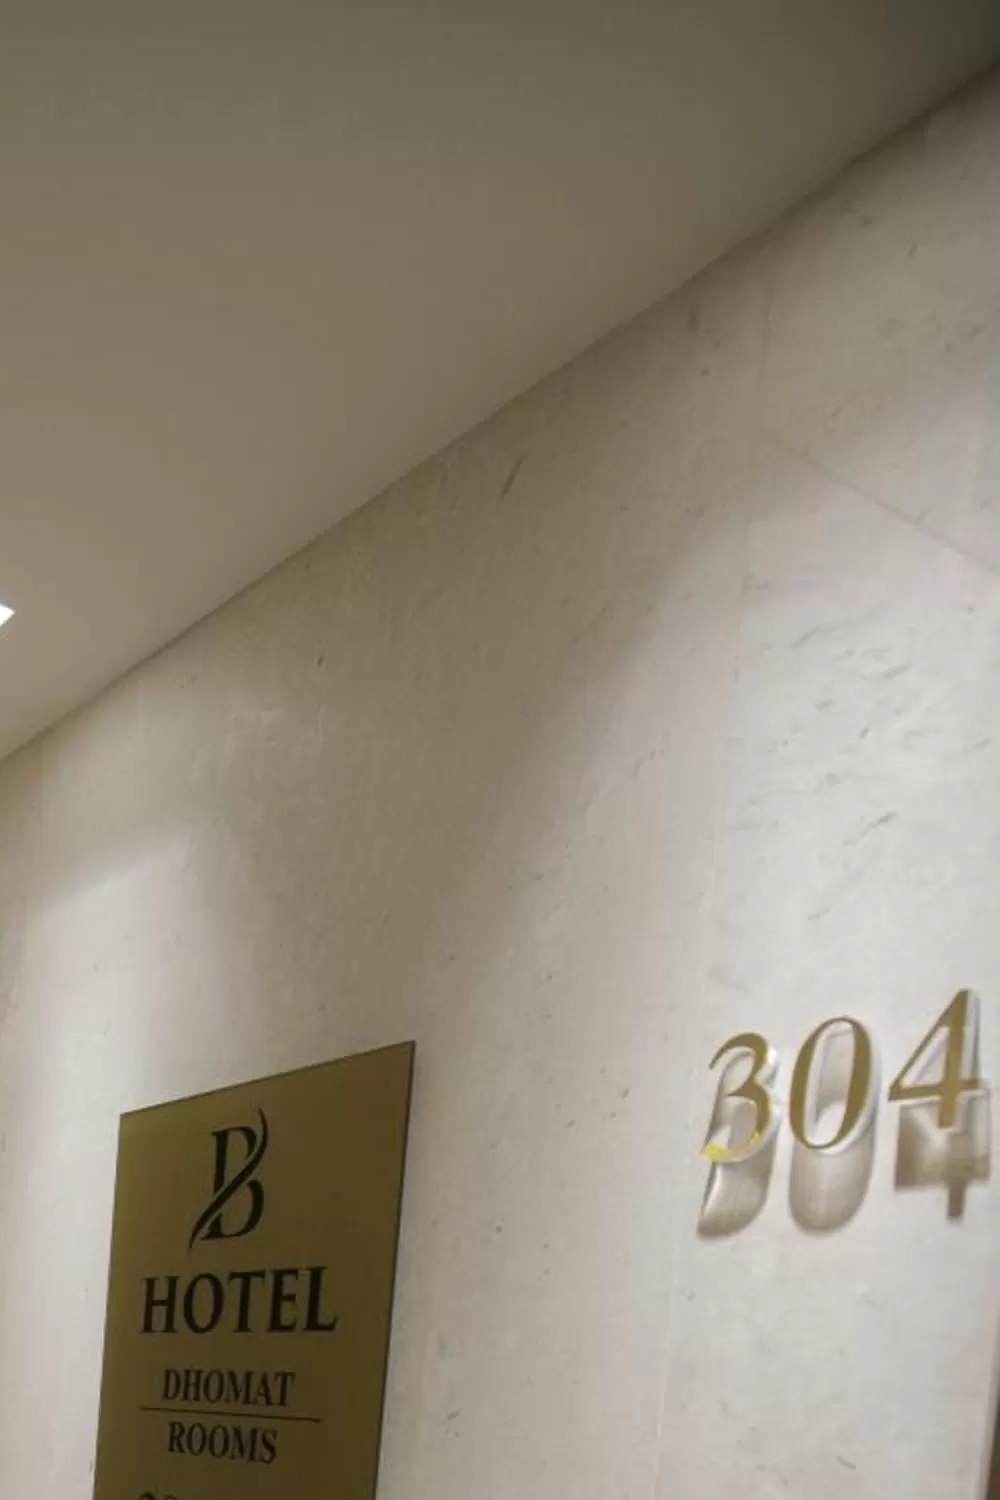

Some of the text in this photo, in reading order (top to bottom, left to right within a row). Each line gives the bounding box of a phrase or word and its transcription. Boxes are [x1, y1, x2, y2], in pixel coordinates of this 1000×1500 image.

[700, 988, 980, 1164] 304
[140, 1267, 338, 1334] HOTEL
[162, 1368, 295, 1407] DHOMAT
[167, 1421, 278, 1464] ROOMS
